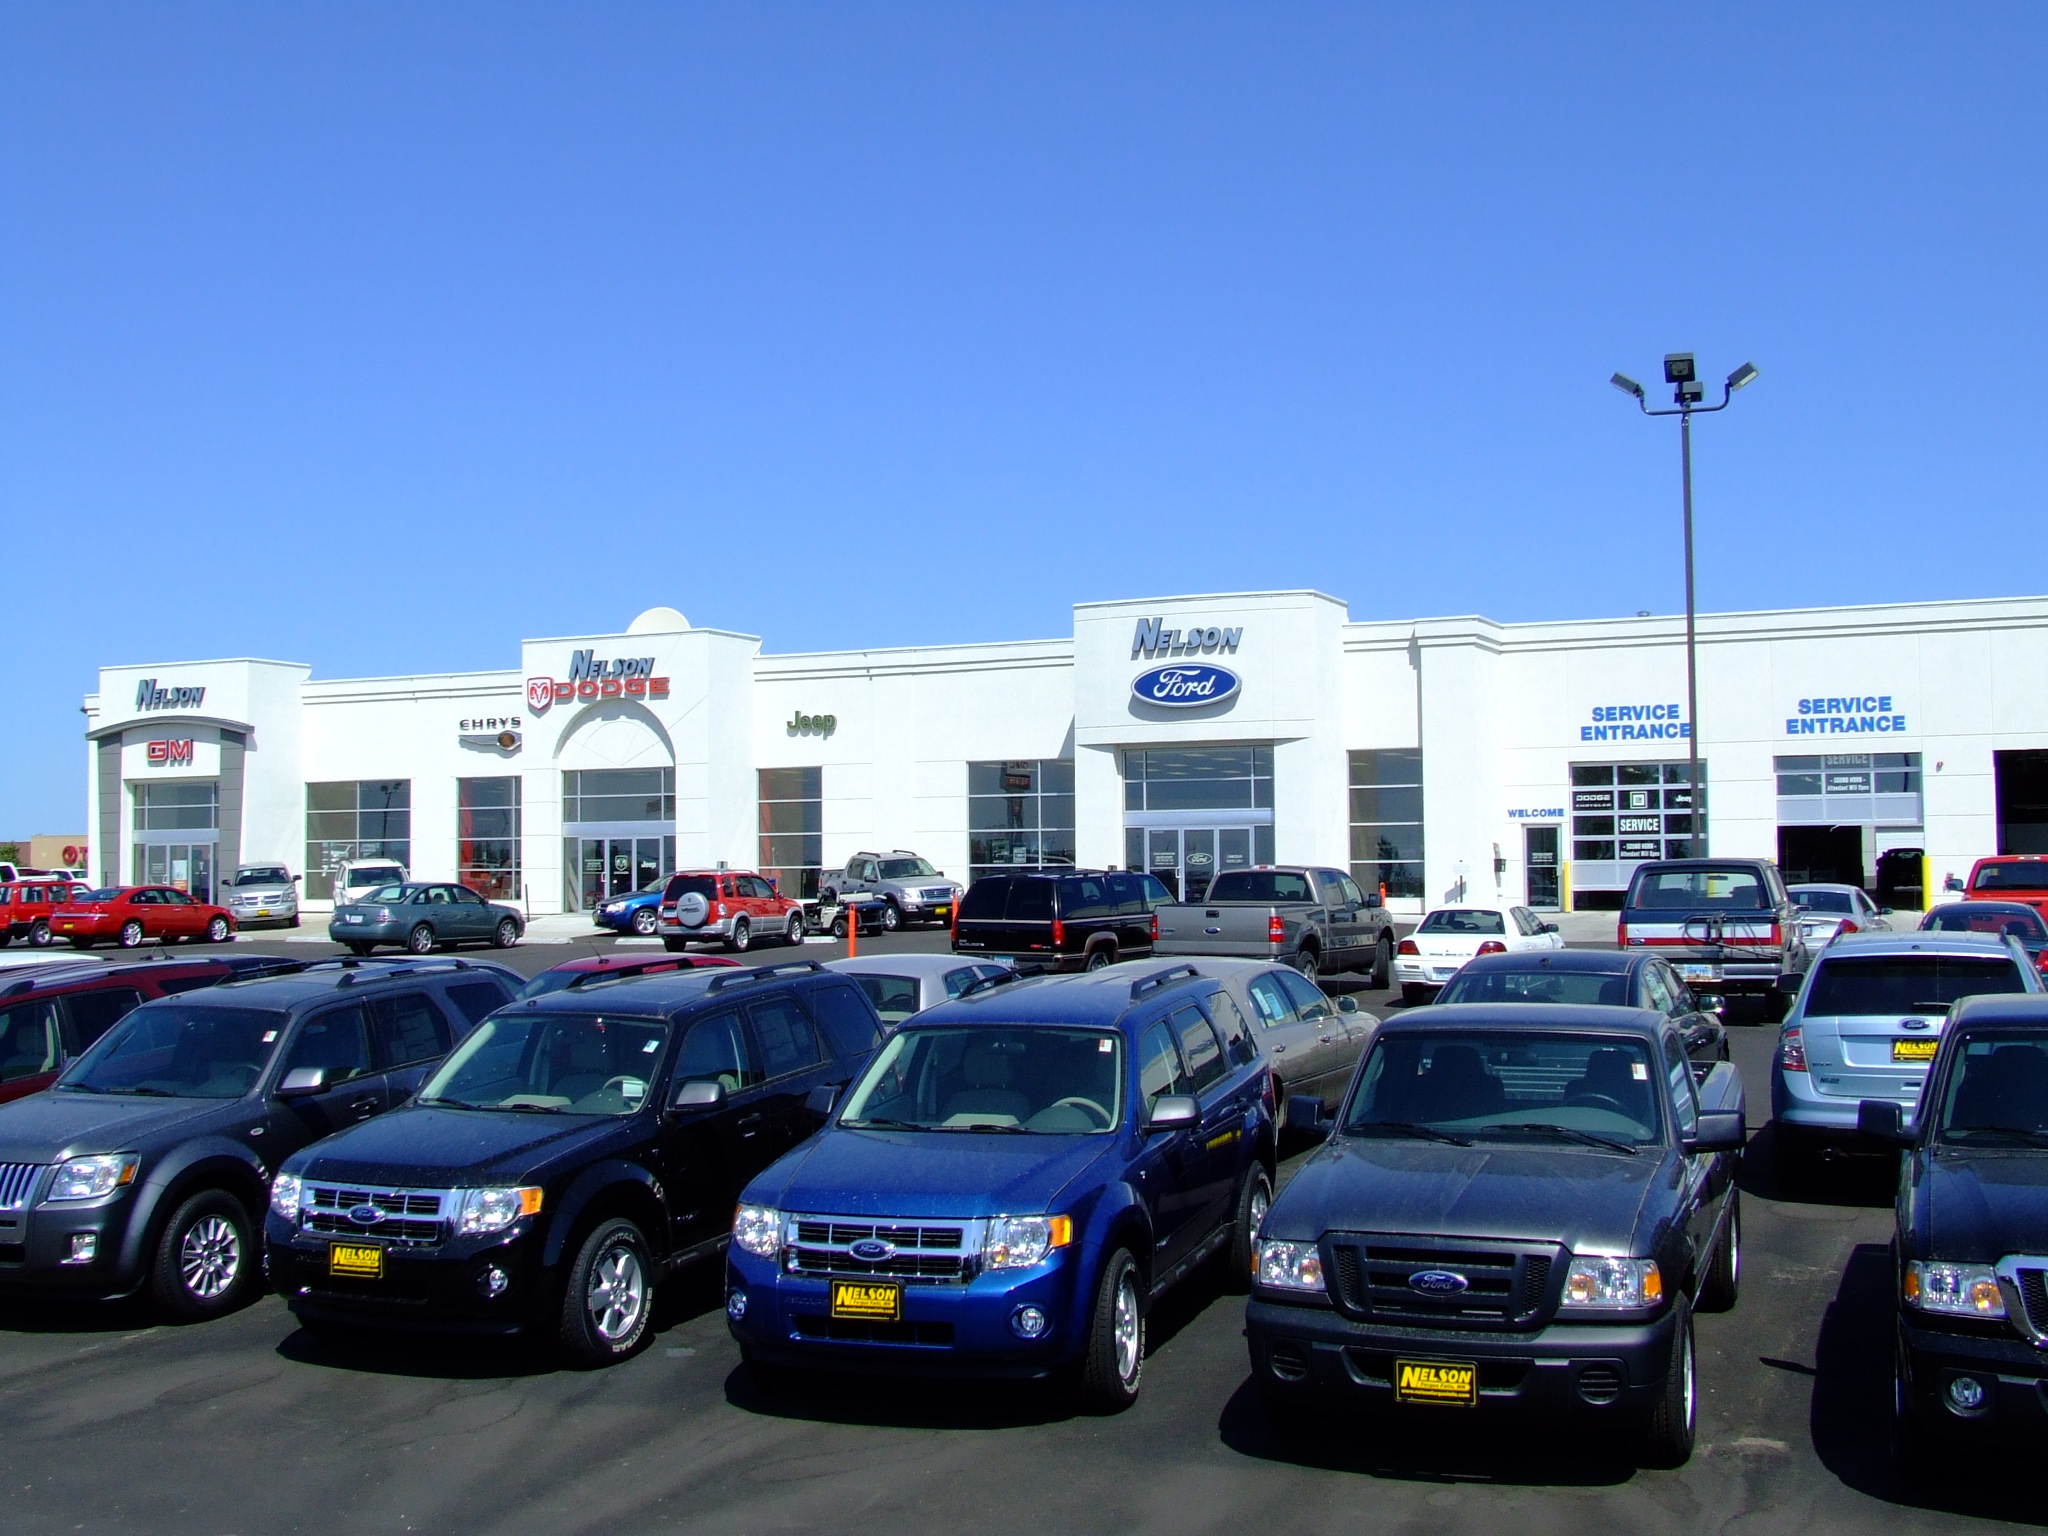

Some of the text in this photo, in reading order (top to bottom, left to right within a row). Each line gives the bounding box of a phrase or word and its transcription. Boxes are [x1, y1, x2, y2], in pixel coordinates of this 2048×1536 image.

[1131, 617, 1243, 653] NELSON
[569, 649, 655, 679] NELSON
[135, 679, 206, 706] NELSON
[554, 677, 670, 698] DODGE
[1153, 669, 1216, 698] Ford
[1591, 704, 1680, 722] SERVICE
[1797, 696, 1892, 715] SERVICE
[787, 711, 837, 732] Jeep
[1580, 722, 1692, 741] ENTRANCE
[1786, 715, 1906, 735] ENTRANCE
[147, 739, 193, 760] GM
[1827, 754, 1868, 764] SERVICE
[1507, 808, 1564, 818] WELCOME
[1619, 818, 1659, 832] SERVICE
[640, 860, 657, 869] Jeep
[333, 1247, 380, 1265] NELSON
[1421, 1274, 1453, 1290] Ford
[836, 1286, 896, 1306] NELSON
[1400, 1366, 1472, 1388] NELSON
